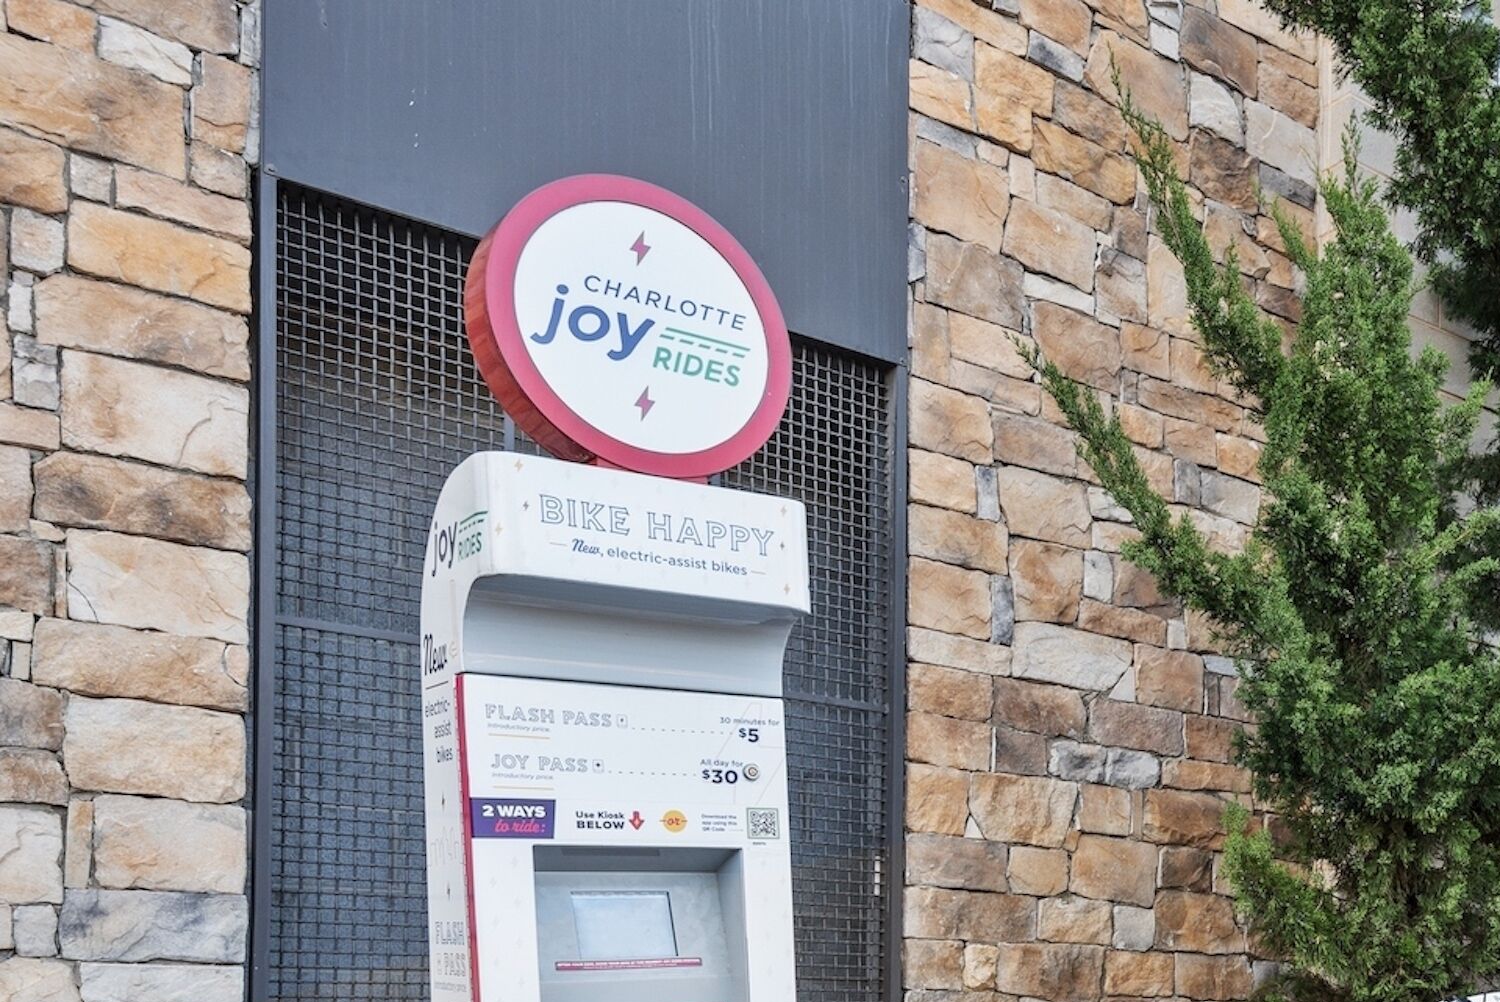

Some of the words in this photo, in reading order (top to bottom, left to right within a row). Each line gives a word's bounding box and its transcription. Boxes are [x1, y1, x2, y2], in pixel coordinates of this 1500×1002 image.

[583, 274, 748, 332] CHARLOTTE
[530, 284, 656, 362] joy
[652, 345, 742, 388] RIDES
[539, 493, 632, 538] BIKE
[647, 510, 775, 558] HAPPY
[431, 521, 458, 577] joy
[458, 531, 482, 562] RIDES
[572, 538, 605, 559] New,
[607, 546, 708, 572] electric-assist
[711, 559, 749, 577] bikes
[424, 697, 451, 718] electric-
[485, 703, 555, 724] FLASH
[562, 710, 612, 728] PASS
[433, 720, 452, 739] assist
[733, 718, 766, 726] minutes
[739, 728, 759, 743] $5
[436, 745, 454, 763] bikes
[491, 753, 530, 771] JOY
[538, 756, 589, 773] PASS
[713, 759, 730, 768] day
[702, 769, 738, 784] $30
[482, 805, 494, 817] 2
[496, 805, 546, 818] WAYS
[575, 810, 595, 819] Use
[598, 810, 625, 820] Kiosk
[494, 819, 509, 833] to
[512, 819, 546, 833] ride:
[576, 820, 625, 830] BELOW
[667, 818, 681, 826] or
[435, 920, 465, 946] FLASH
[443, 951, 466, 977] PASS
